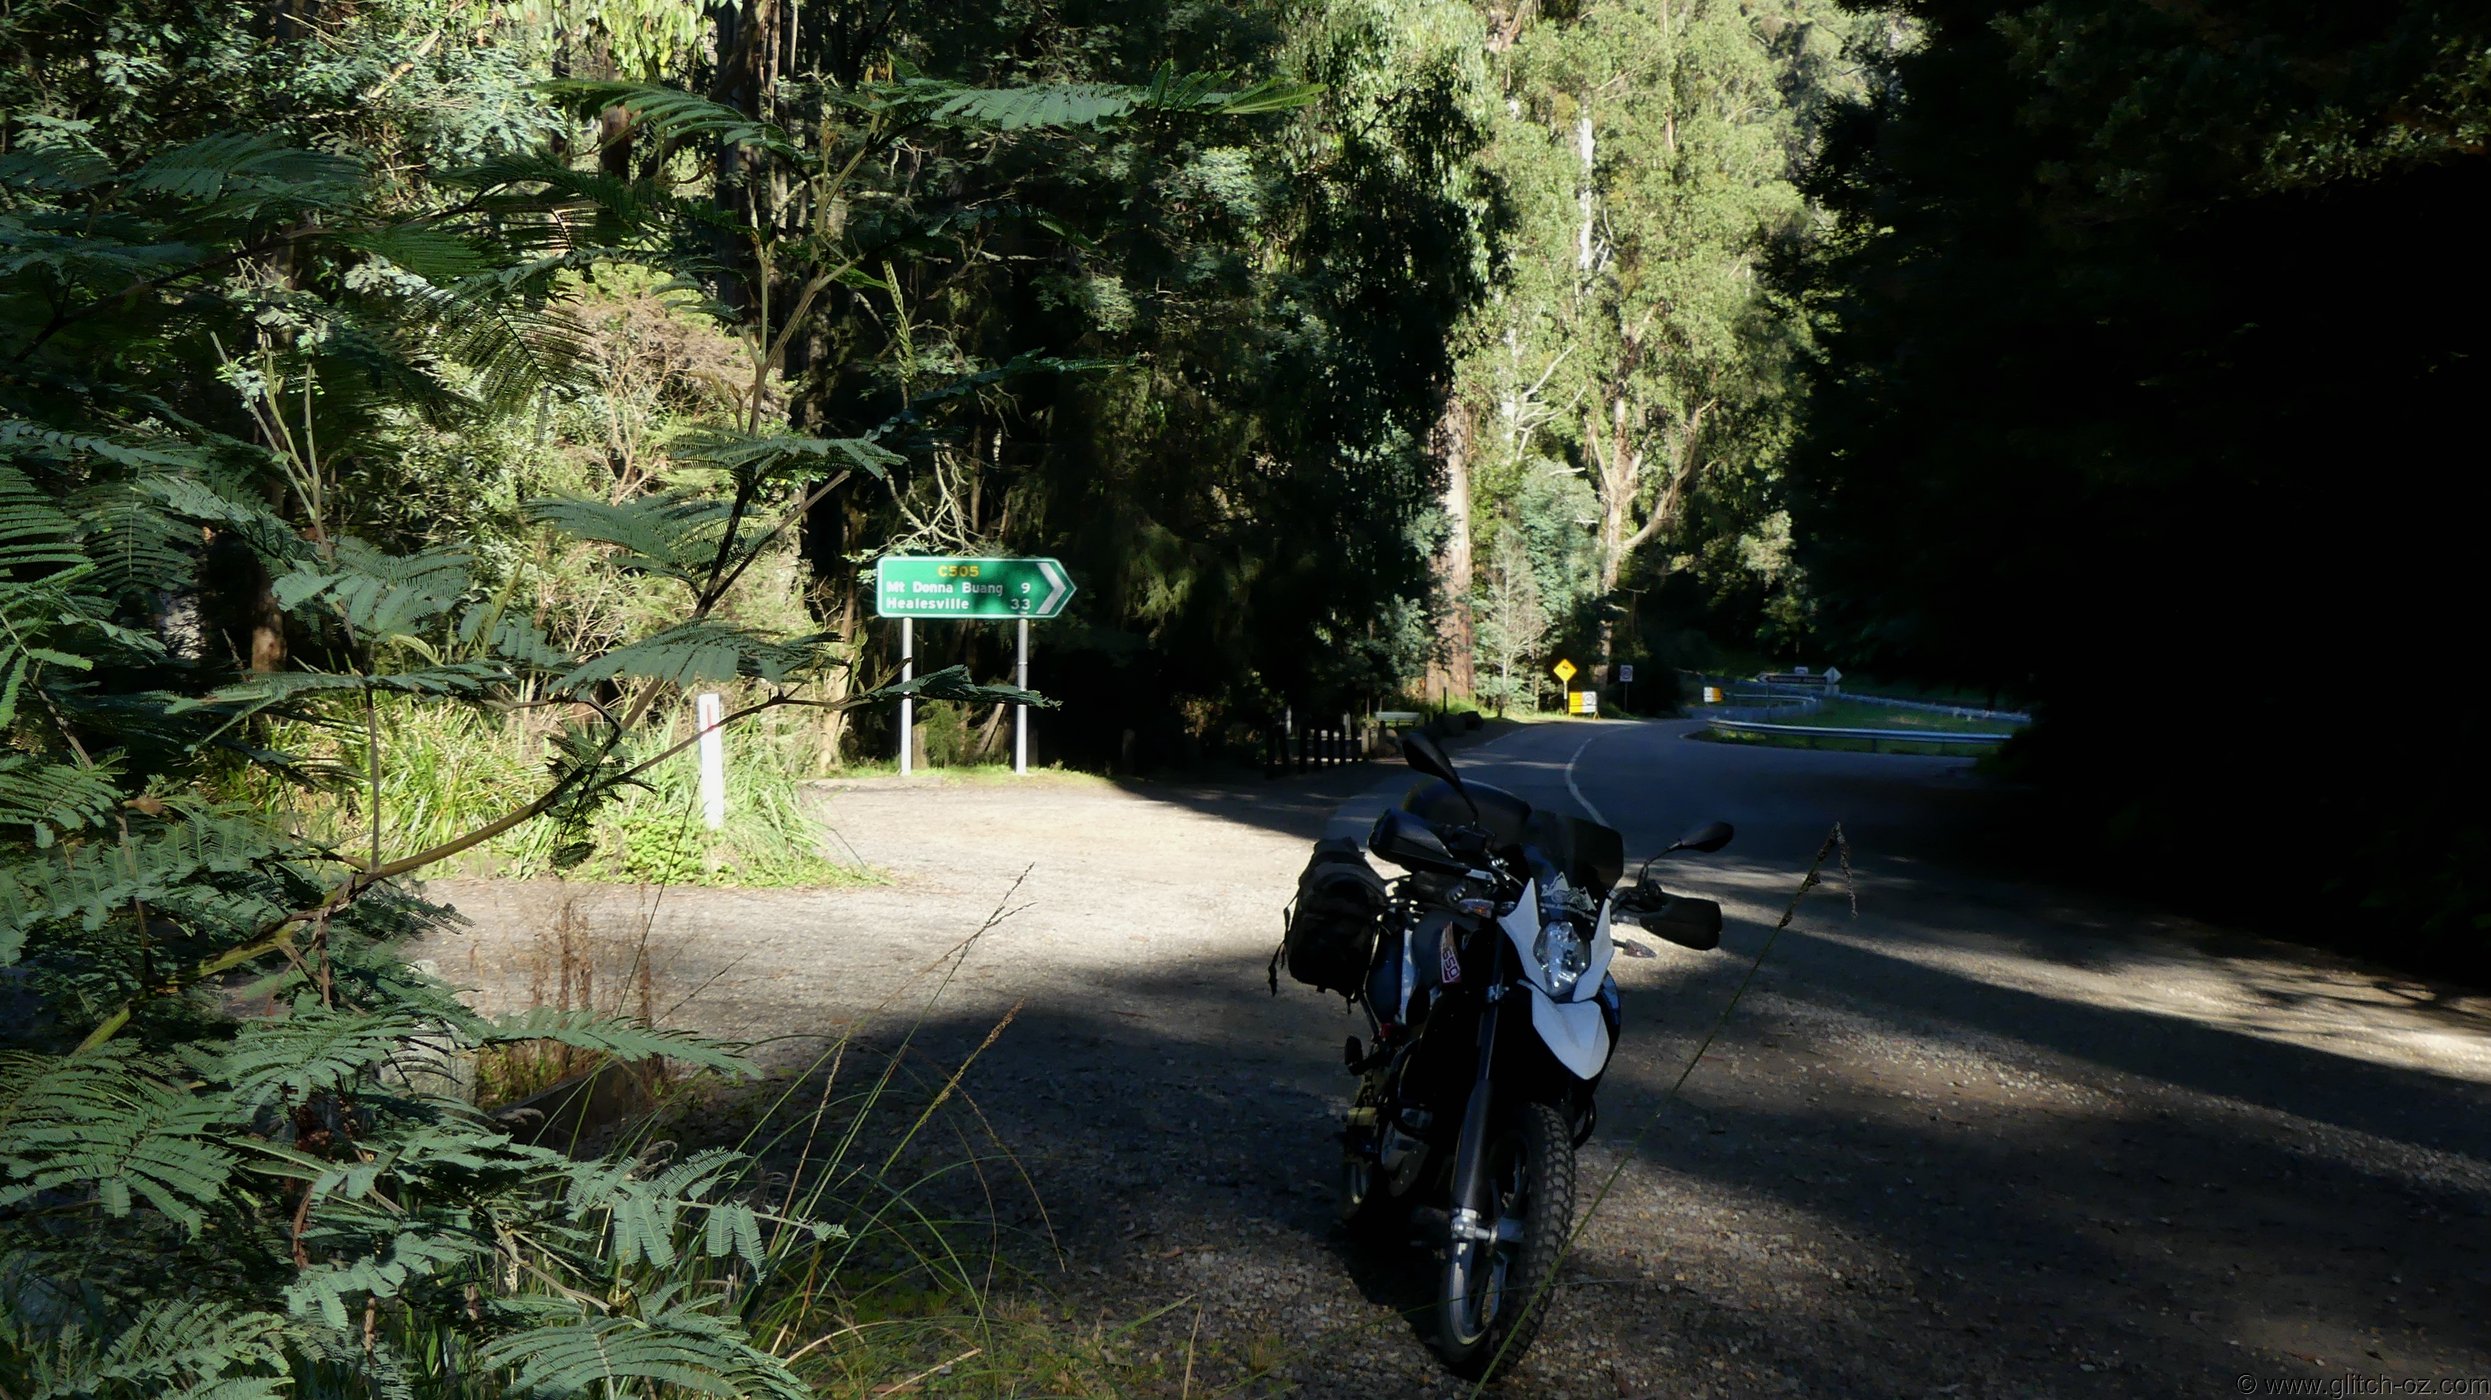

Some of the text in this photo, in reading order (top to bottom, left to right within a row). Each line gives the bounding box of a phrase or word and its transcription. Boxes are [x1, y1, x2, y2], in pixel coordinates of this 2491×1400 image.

[937, 565, 980, 577] C505
[886, 581, 1031, 596] Mt Donna Buang 9
[886, 597, 1031, 610] Healesville 33
